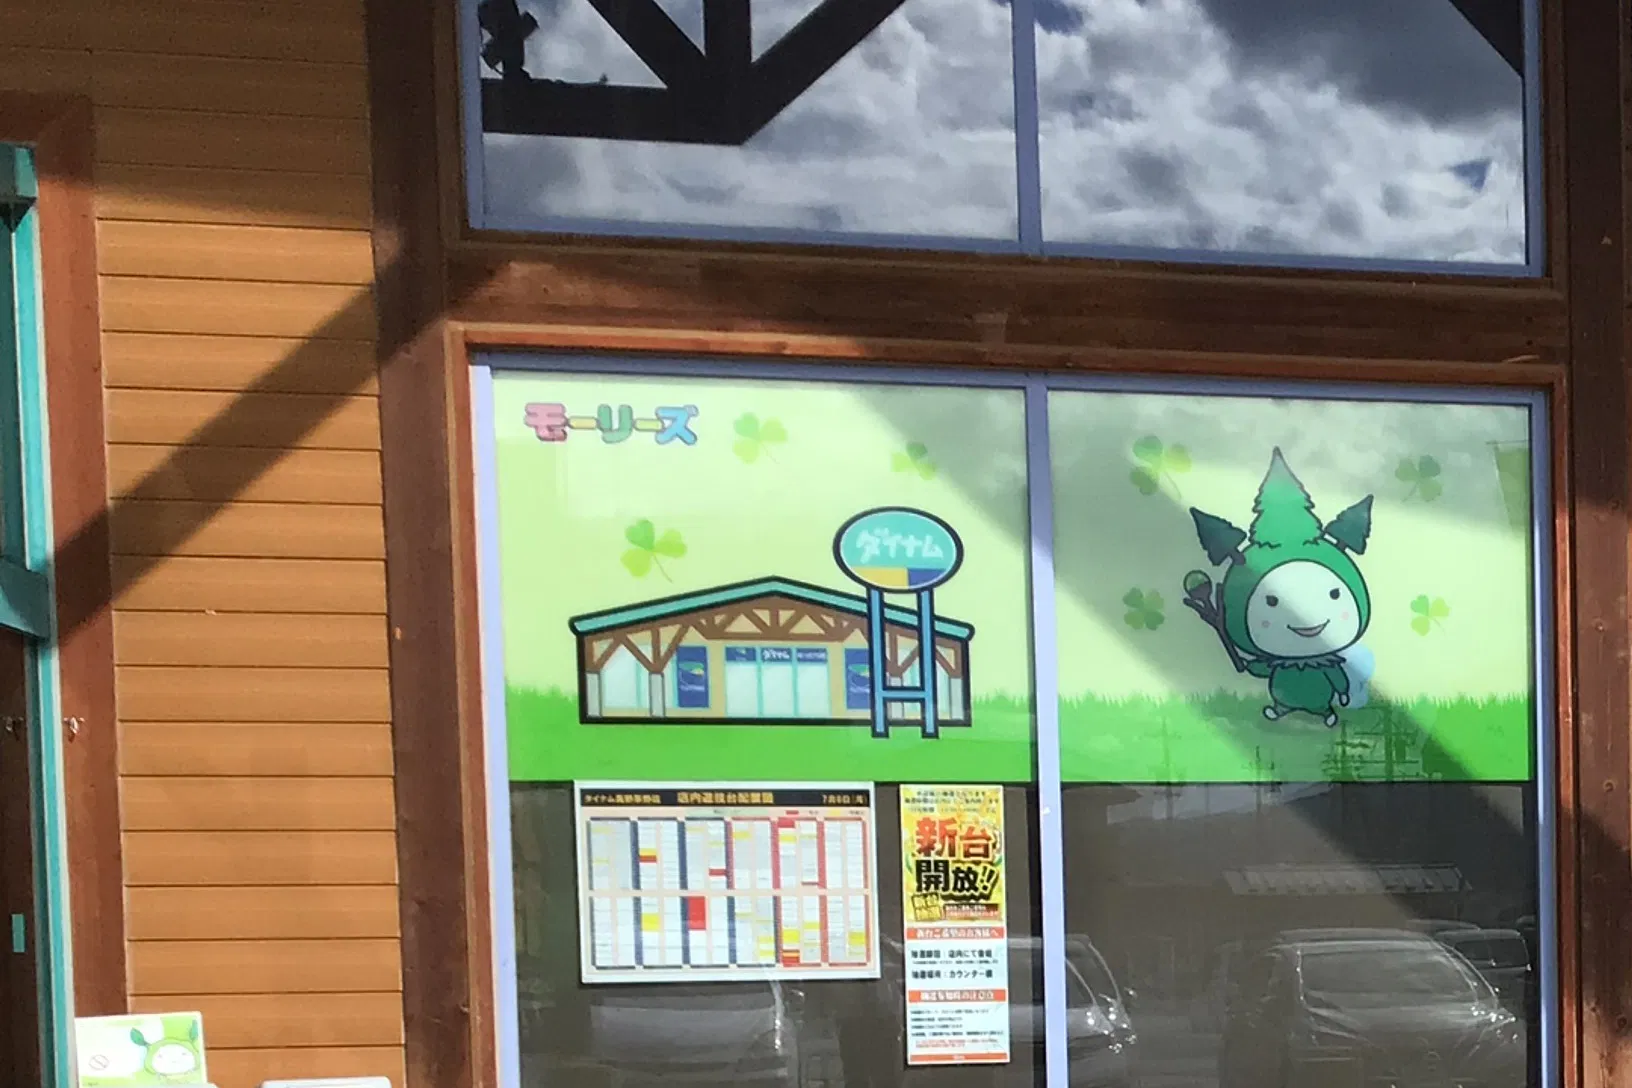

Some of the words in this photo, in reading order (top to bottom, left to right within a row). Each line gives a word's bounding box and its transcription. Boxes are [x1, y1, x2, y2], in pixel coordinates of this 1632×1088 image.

[524, 402, 700, 446] モーリーズ
[856, 530, 944, 562] ダイナム
[914, 815, 995, 859] 新台
